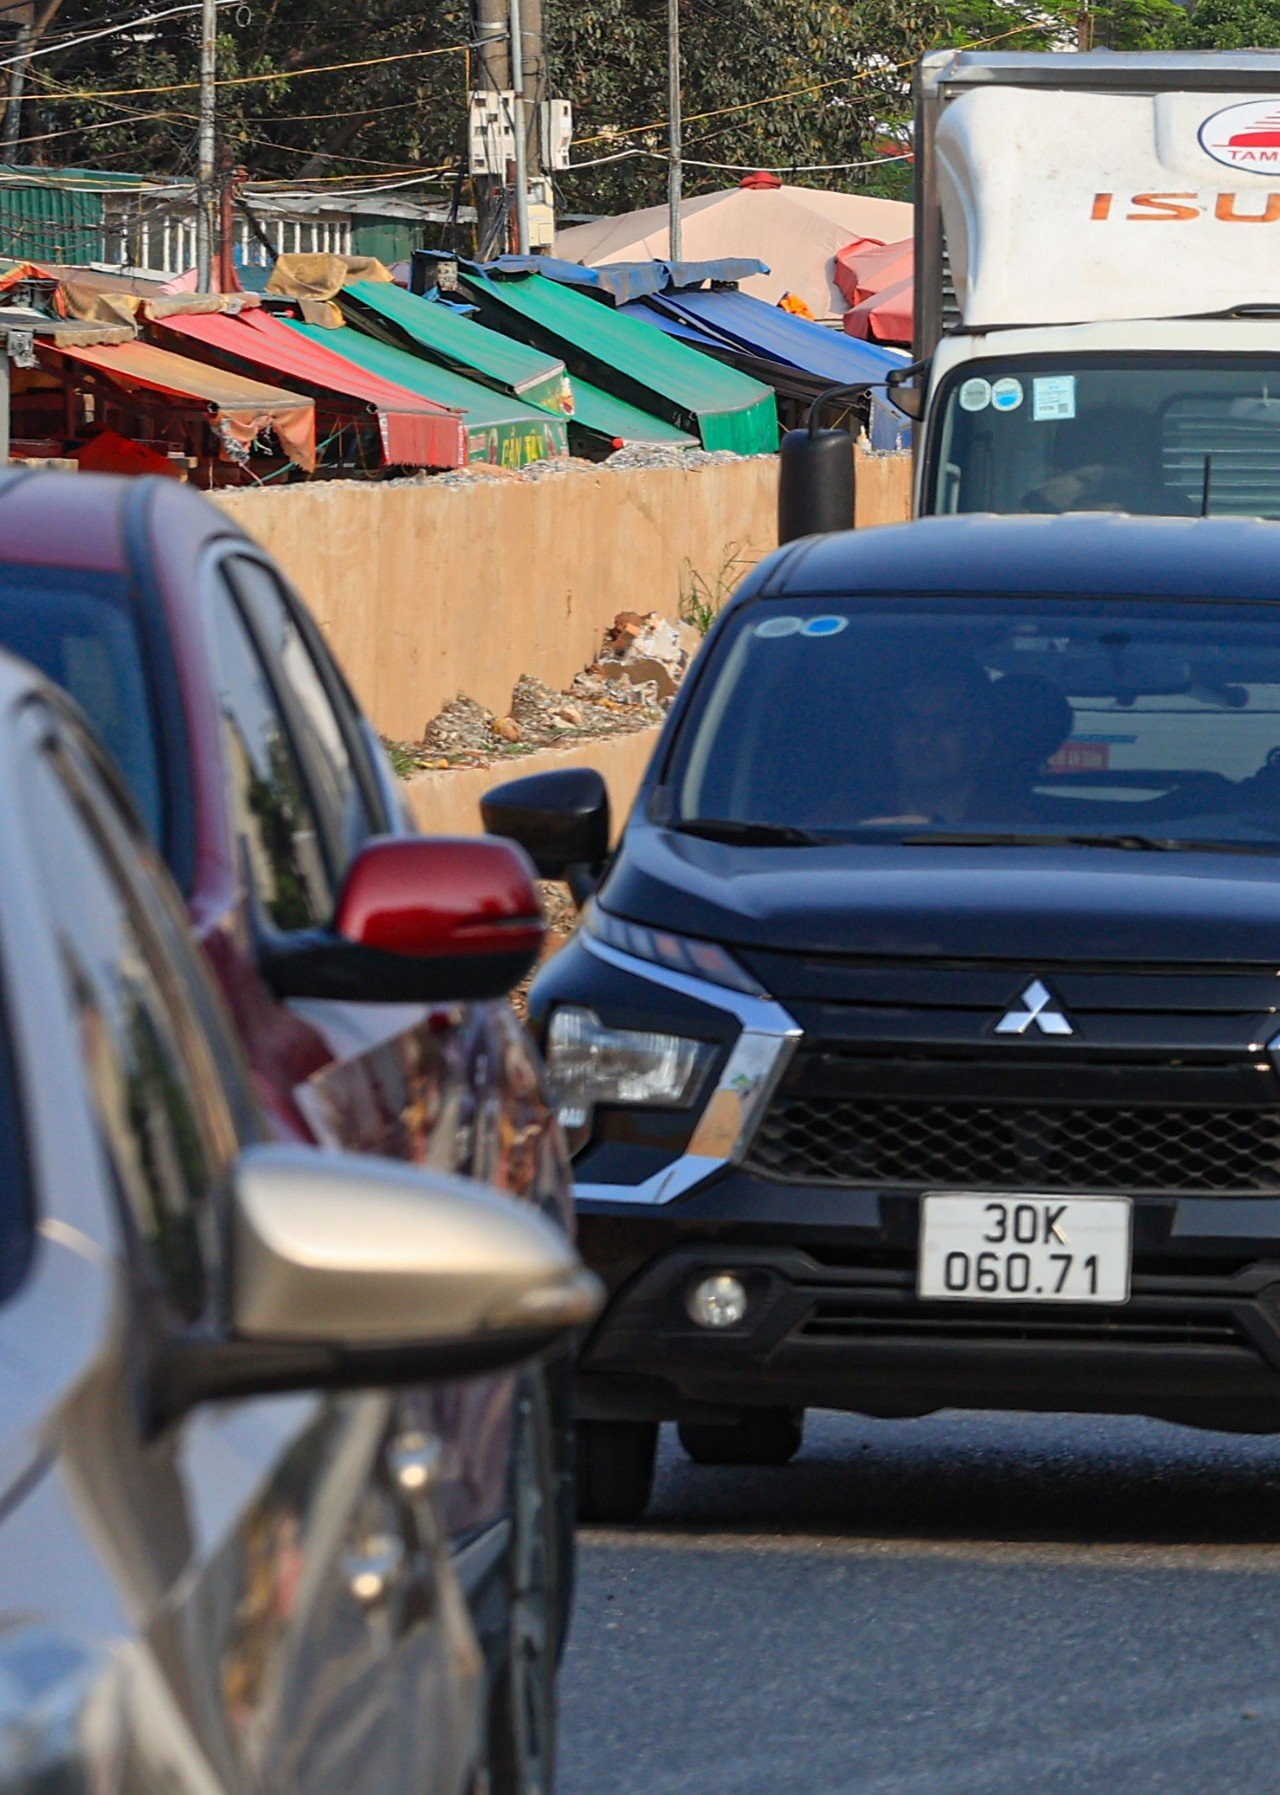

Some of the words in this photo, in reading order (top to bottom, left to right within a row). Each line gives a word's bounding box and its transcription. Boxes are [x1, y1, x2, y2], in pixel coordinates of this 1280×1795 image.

[1227, 150, 1278, 162] TAM
[983, 1203, 1069, 1246] 30K
[944, 1251, 1099, 1295] 060.71
